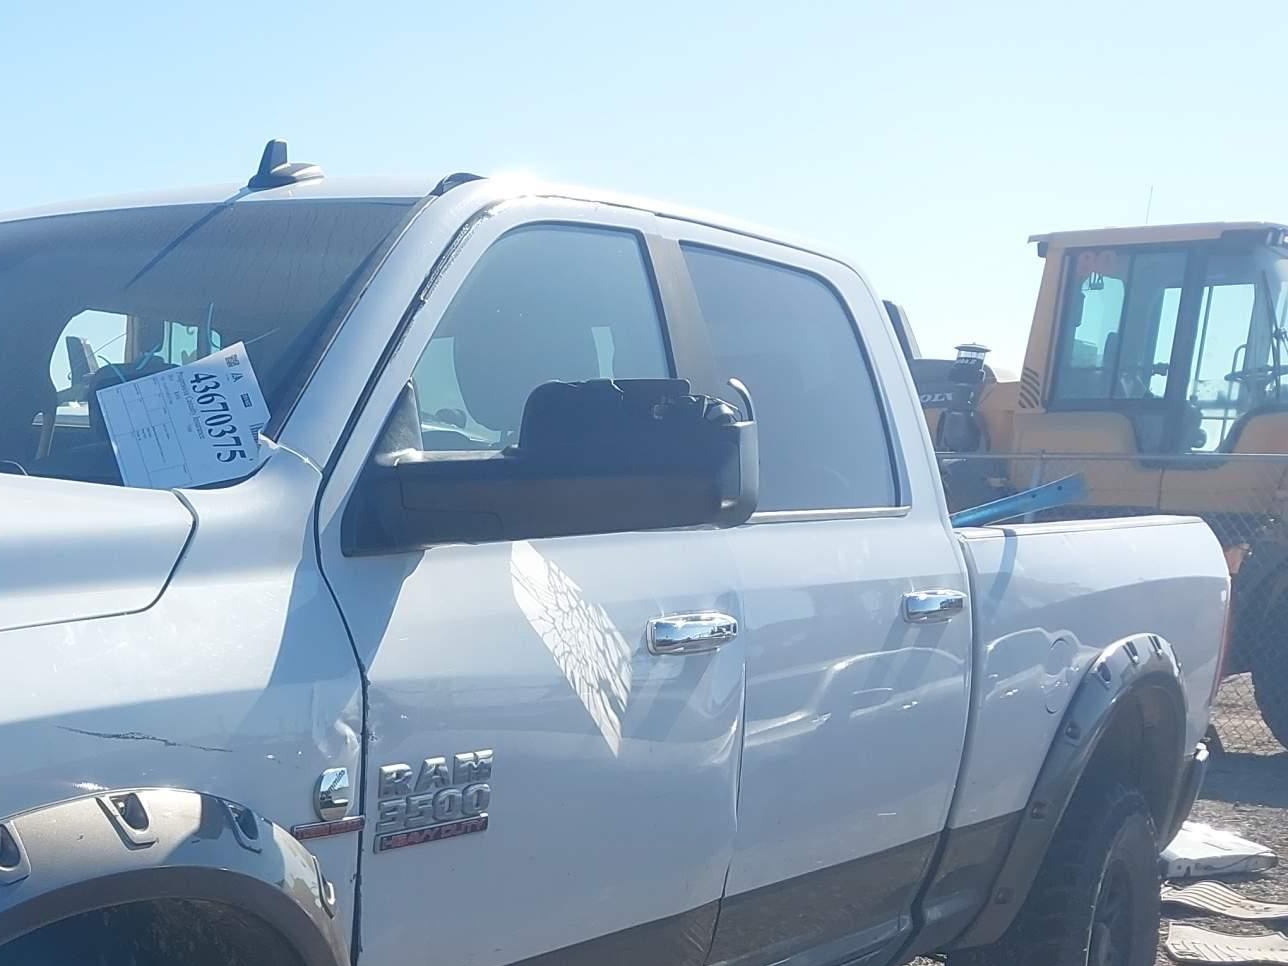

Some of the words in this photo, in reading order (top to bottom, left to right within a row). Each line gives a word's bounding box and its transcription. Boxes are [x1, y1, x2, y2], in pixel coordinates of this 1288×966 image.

[190, 373, 246, 462] 43670375
[378, 749, 494, 798] RAM
[376, 783, 492, 833] 3500
